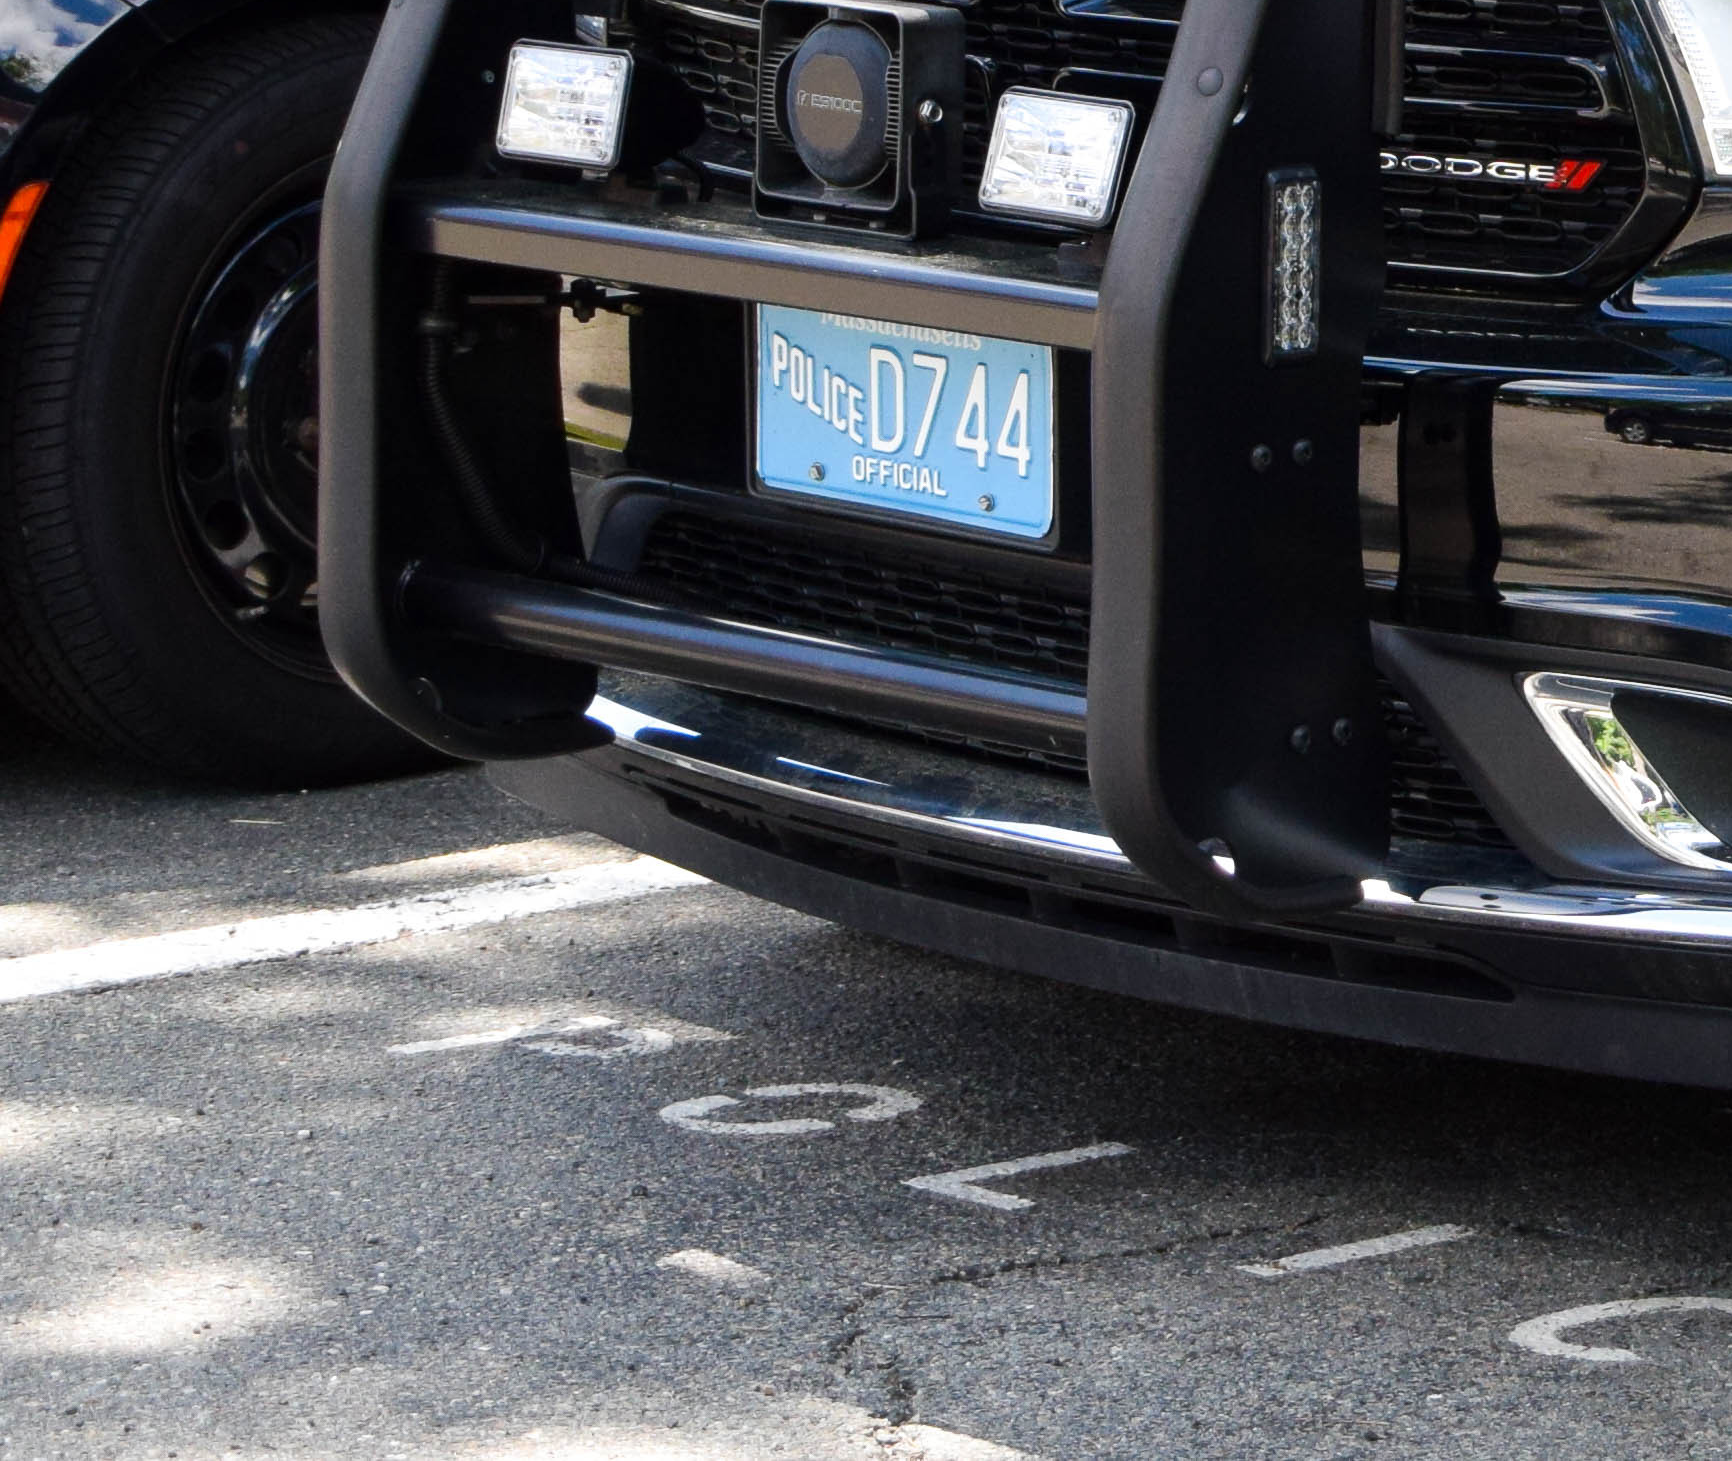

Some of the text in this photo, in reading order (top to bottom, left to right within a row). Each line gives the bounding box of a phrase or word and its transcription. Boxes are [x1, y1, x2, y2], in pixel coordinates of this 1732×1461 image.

[772, 331, 1031, 477] POLICE D744
[852, 455, 948, 497] OFFICIAL
